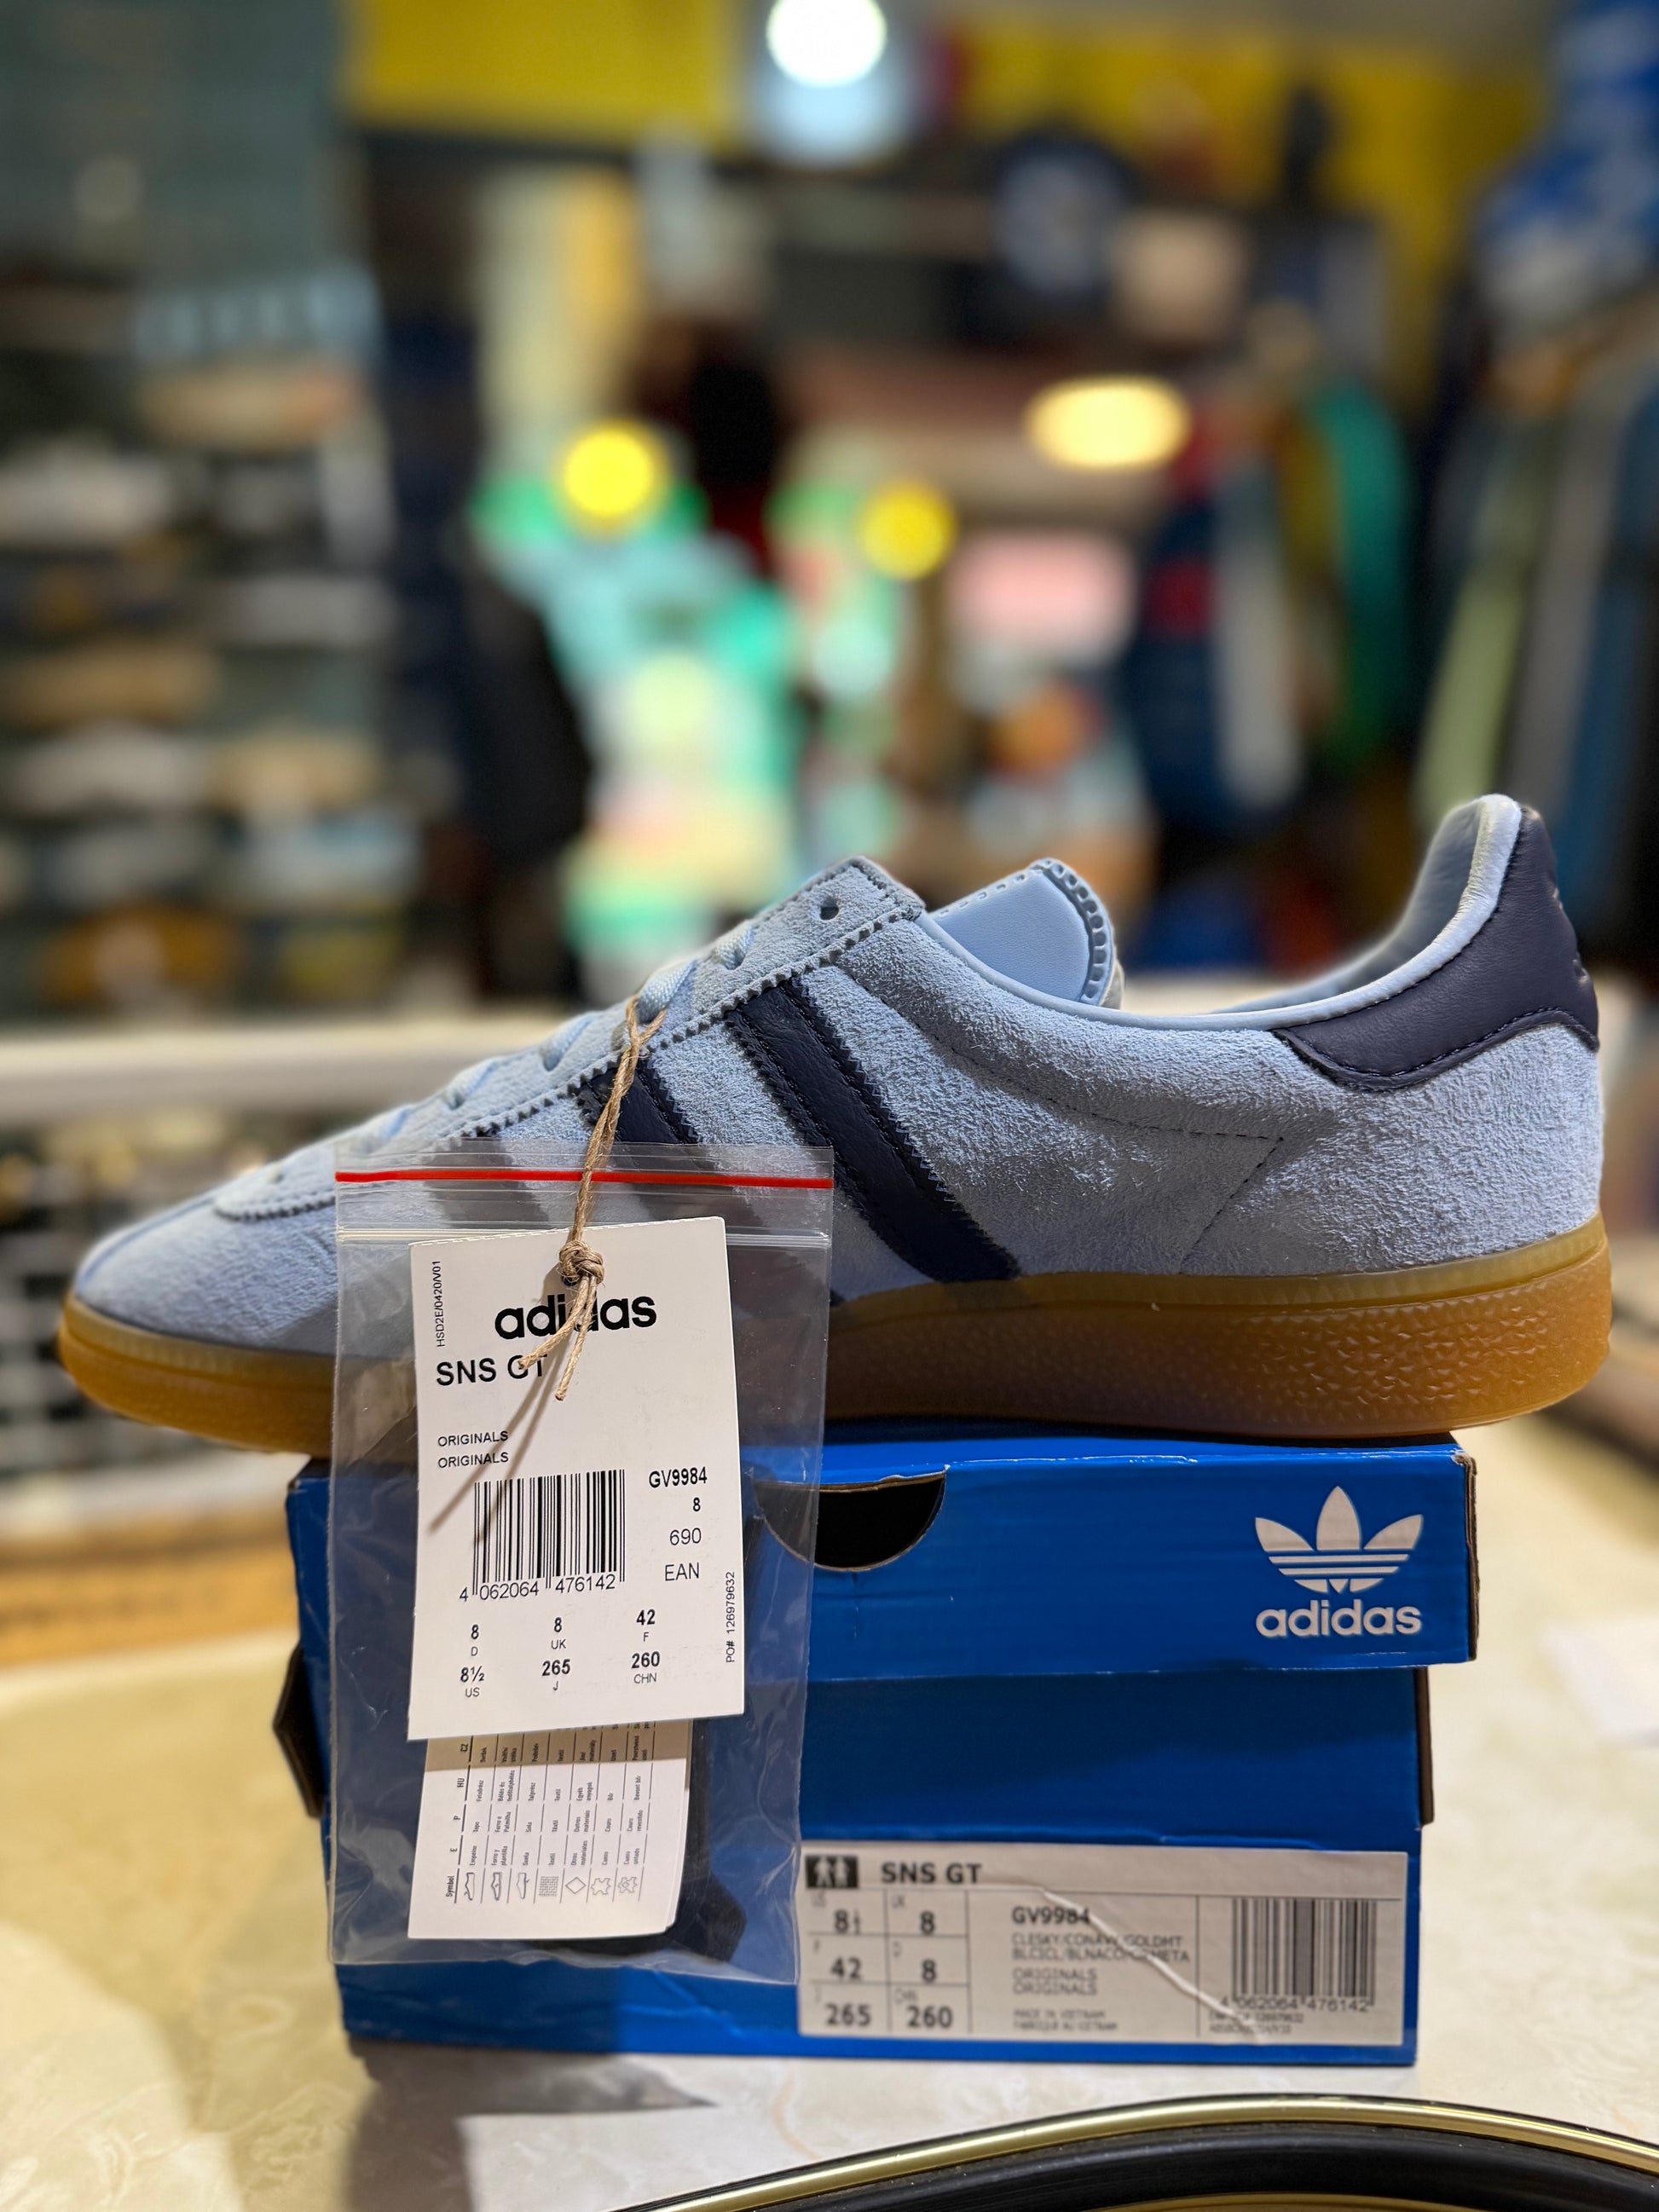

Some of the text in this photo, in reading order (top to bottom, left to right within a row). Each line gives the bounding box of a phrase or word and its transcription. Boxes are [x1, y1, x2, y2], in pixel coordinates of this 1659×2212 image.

[431, 1260, 446, 1347] HSD2E/0420/V01
[436, 1353, 548, 1386] SNS GT
[437, 1430, 509, 1447] ORIGINALS
[437, 1452, 509, 1468] ORIGINALS
[648, 1466, 708, 1488] GV9984
[692, 1497, 701, 1512] 8
[669, 1528, 702, 1545] 690
[664, 1562, 700, 1581] EAN
[460, 1574, 616, 1602] 4 062064 476142
[554, 1617, 562, 1632] 8
[636, 1608, 656, 1626] 42
[725, 1572, 736, 1663] PO# 126979632
[1255, 1599, 1422, 1637] adidas
[471, 1624, 479, 1639] 8
[643, 1632, 650, 1642] F
[471, 1647, 478, 1656] D
[551, 1639, 566, 1649] UK
[541, 1659, 570, 1676] 265
[631, 1651, 660, 1669] 260
[552, 1681, 558, 1690] J
[633, 1672, 657, 1684] CHN
[465, 1687, 480, 1698] US
[457, 1777, 465, 1788] HU
[881, 1862, 983, 1884] SNS GT
[446, 1875, 455, 1897] Symbol
[920, 1910, 935, 1935] 8
[1012, 1906, 1090, 1925] GV9984
[830, 1956, 861, 1984] 42
[922, 1959, 937, 1984] 8
[1013, 1967, 1097, 1981] ORIGINALS
[1013, 1980, 1097, 1995] ORIGINALS
[1307, 1997, 1370, 2013] 476142
[825, 2003, 871, 2027] 265
[906, 2005, 953, 2028] 260
